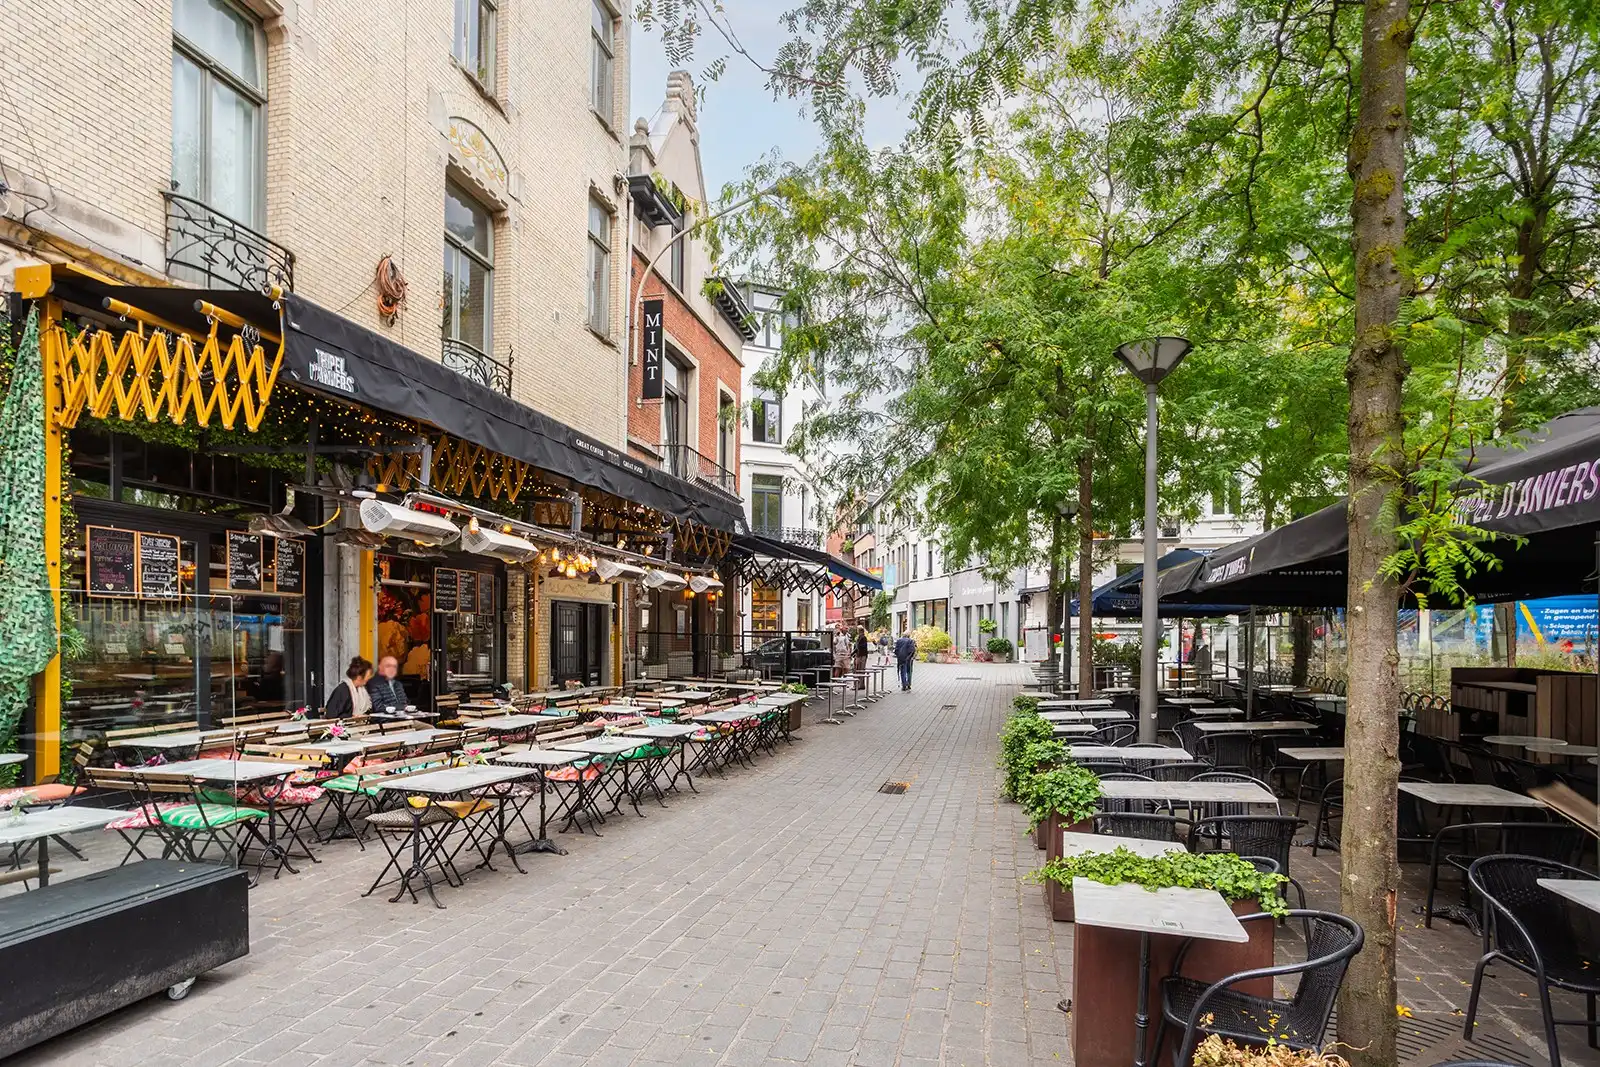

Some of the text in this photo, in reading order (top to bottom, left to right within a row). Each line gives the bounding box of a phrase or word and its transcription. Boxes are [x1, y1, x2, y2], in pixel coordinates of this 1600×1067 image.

[315, 347, 348, 376] TRIPEL
[646, 313, 661, 380] MINT
[309, 361, 355, 393] D'ANVERS
[1496, 457, 1600, 519] D'ANVERS
[1549, 622, 1575, 630] Sciage
